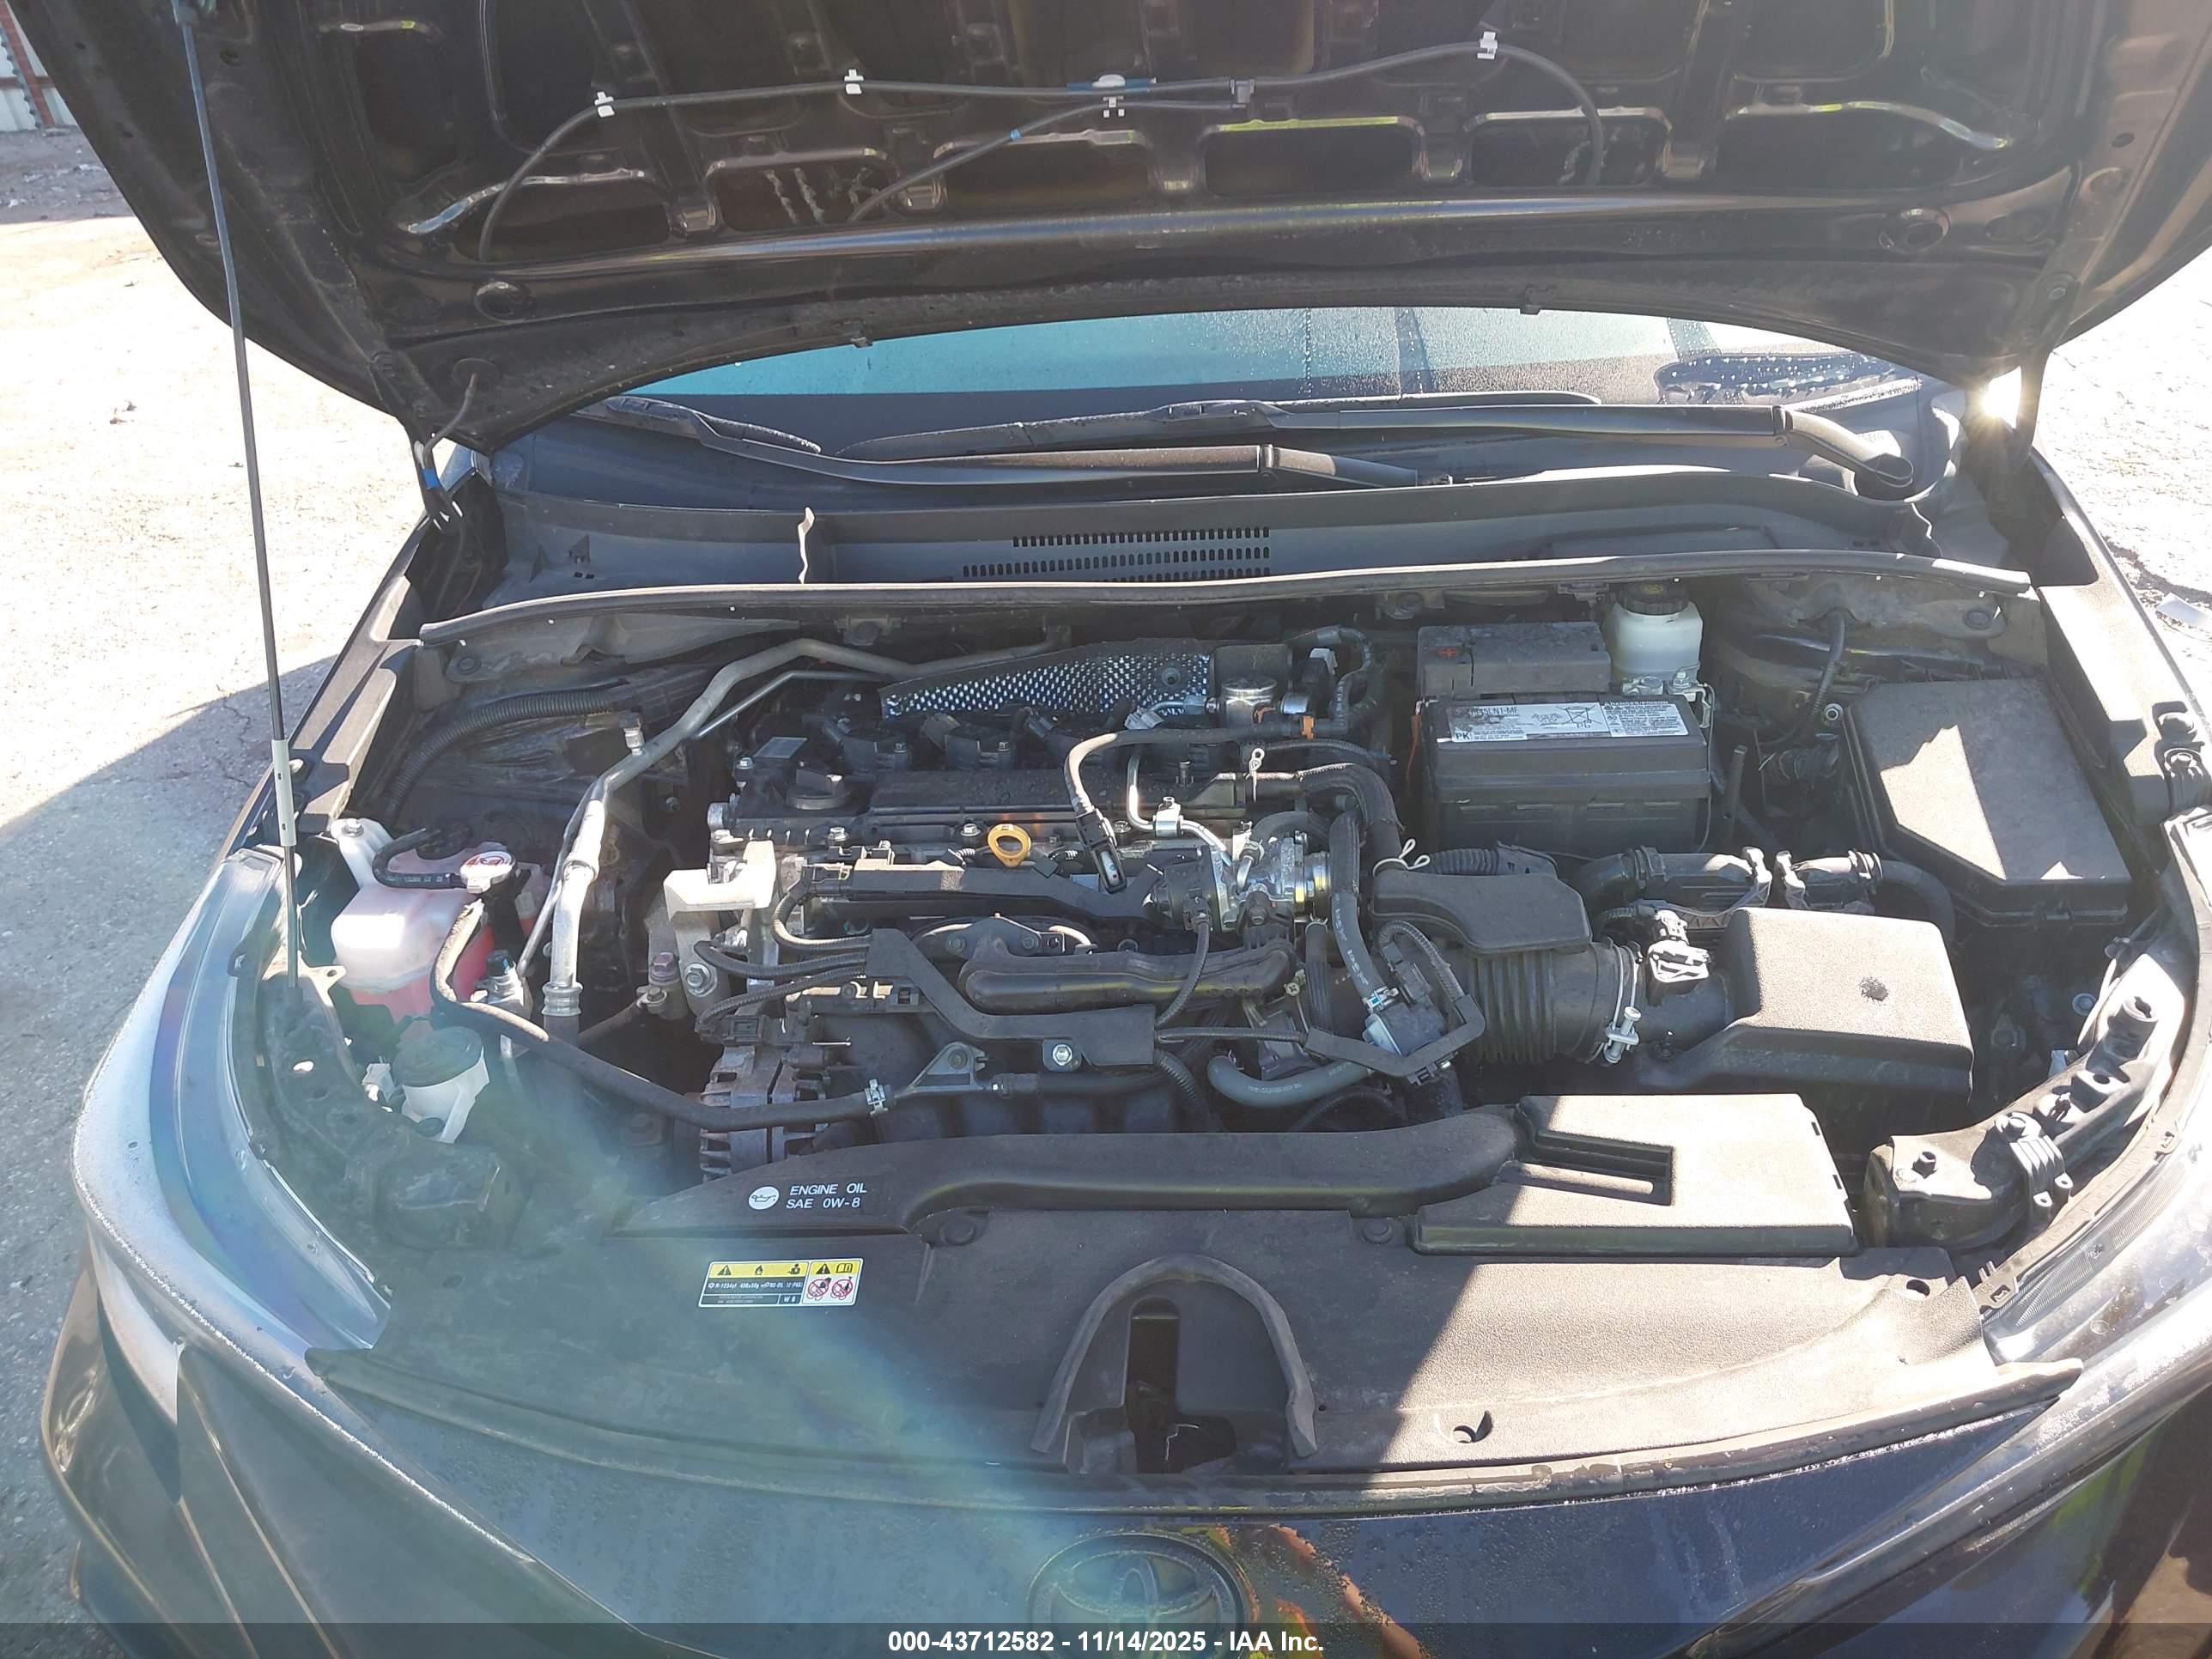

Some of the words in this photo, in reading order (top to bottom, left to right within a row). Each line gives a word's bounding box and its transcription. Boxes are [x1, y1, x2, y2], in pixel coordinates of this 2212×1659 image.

[1455, 732, 1469, 740] PK
[790, 1184, 838, 1195] ENGINE
[847, 1183, 866, 1193] OIL
[787, 1199, 813, 1208] SAE
[823, 1198, 860, 1207] 0W-8
